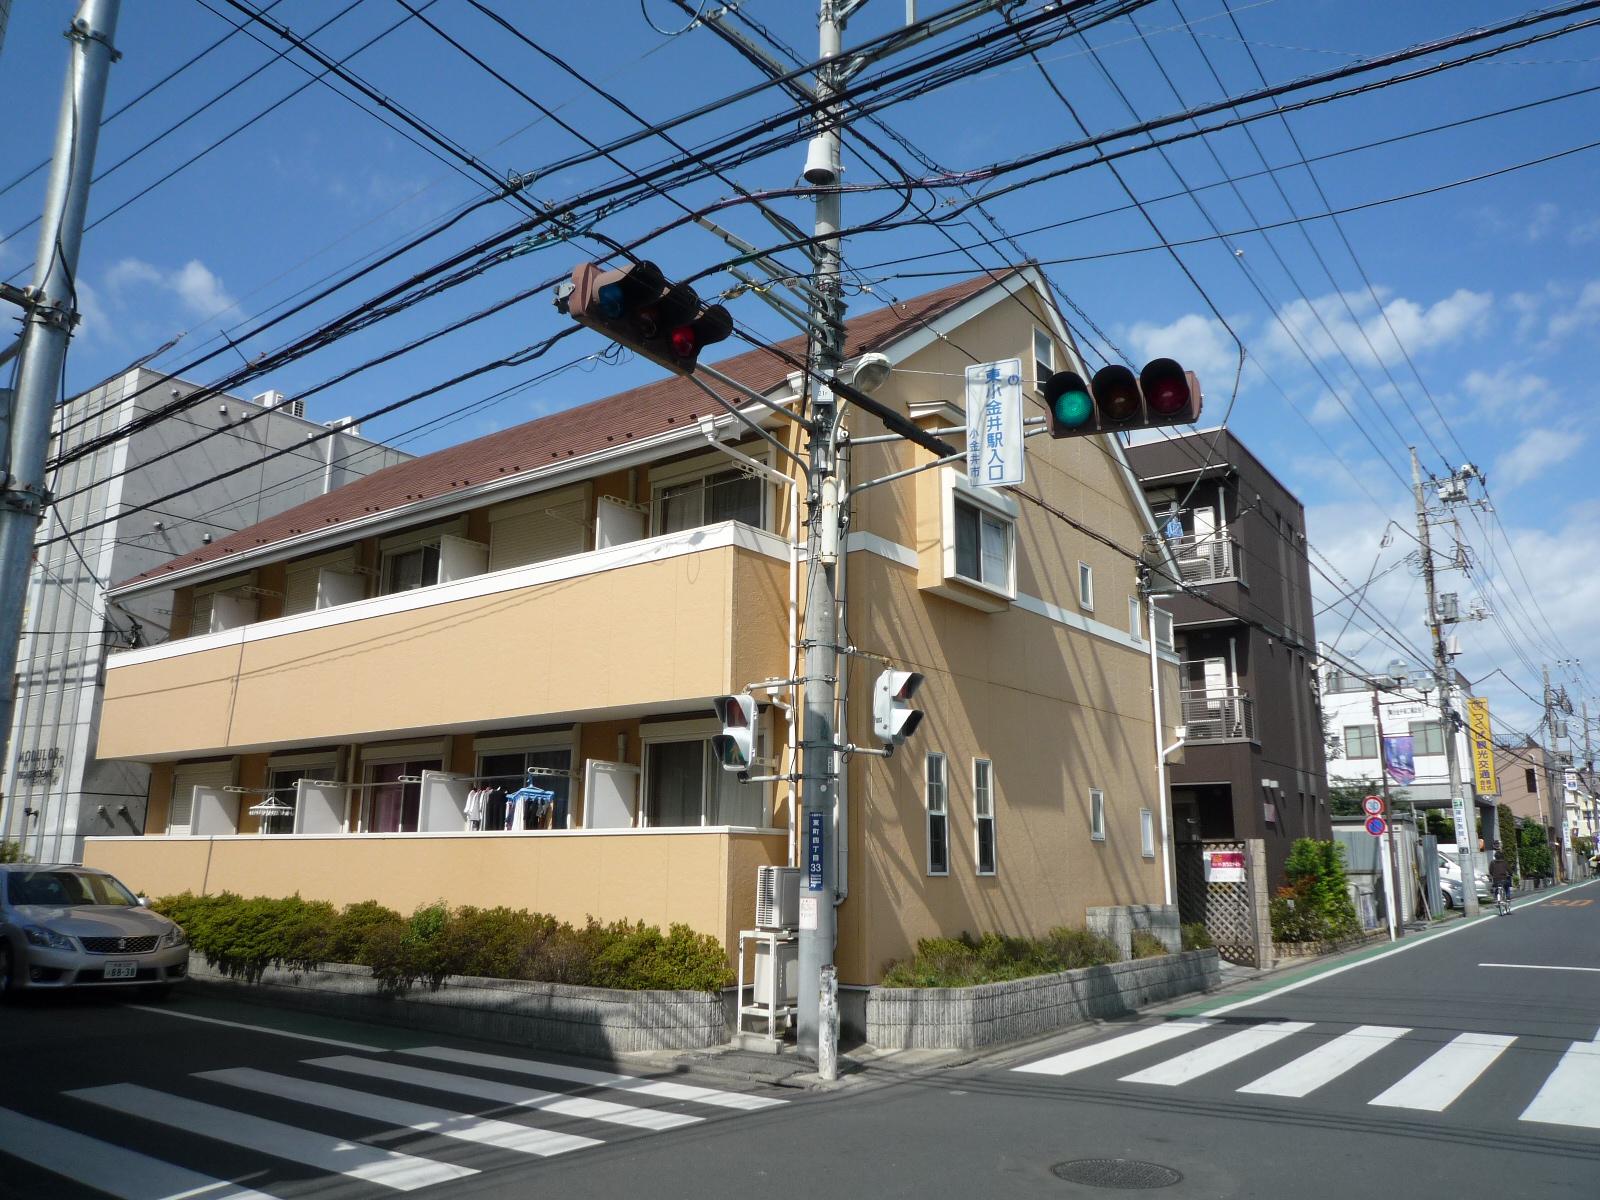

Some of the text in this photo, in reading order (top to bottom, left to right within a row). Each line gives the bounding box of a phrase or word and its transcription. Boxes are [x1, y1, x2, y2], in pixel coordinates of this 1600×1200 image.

[985, 368, 1004, 481] 東小金井駅入口
[969, 428, 980, 478] 小金井市
[810, 863, 822, 872] 33
